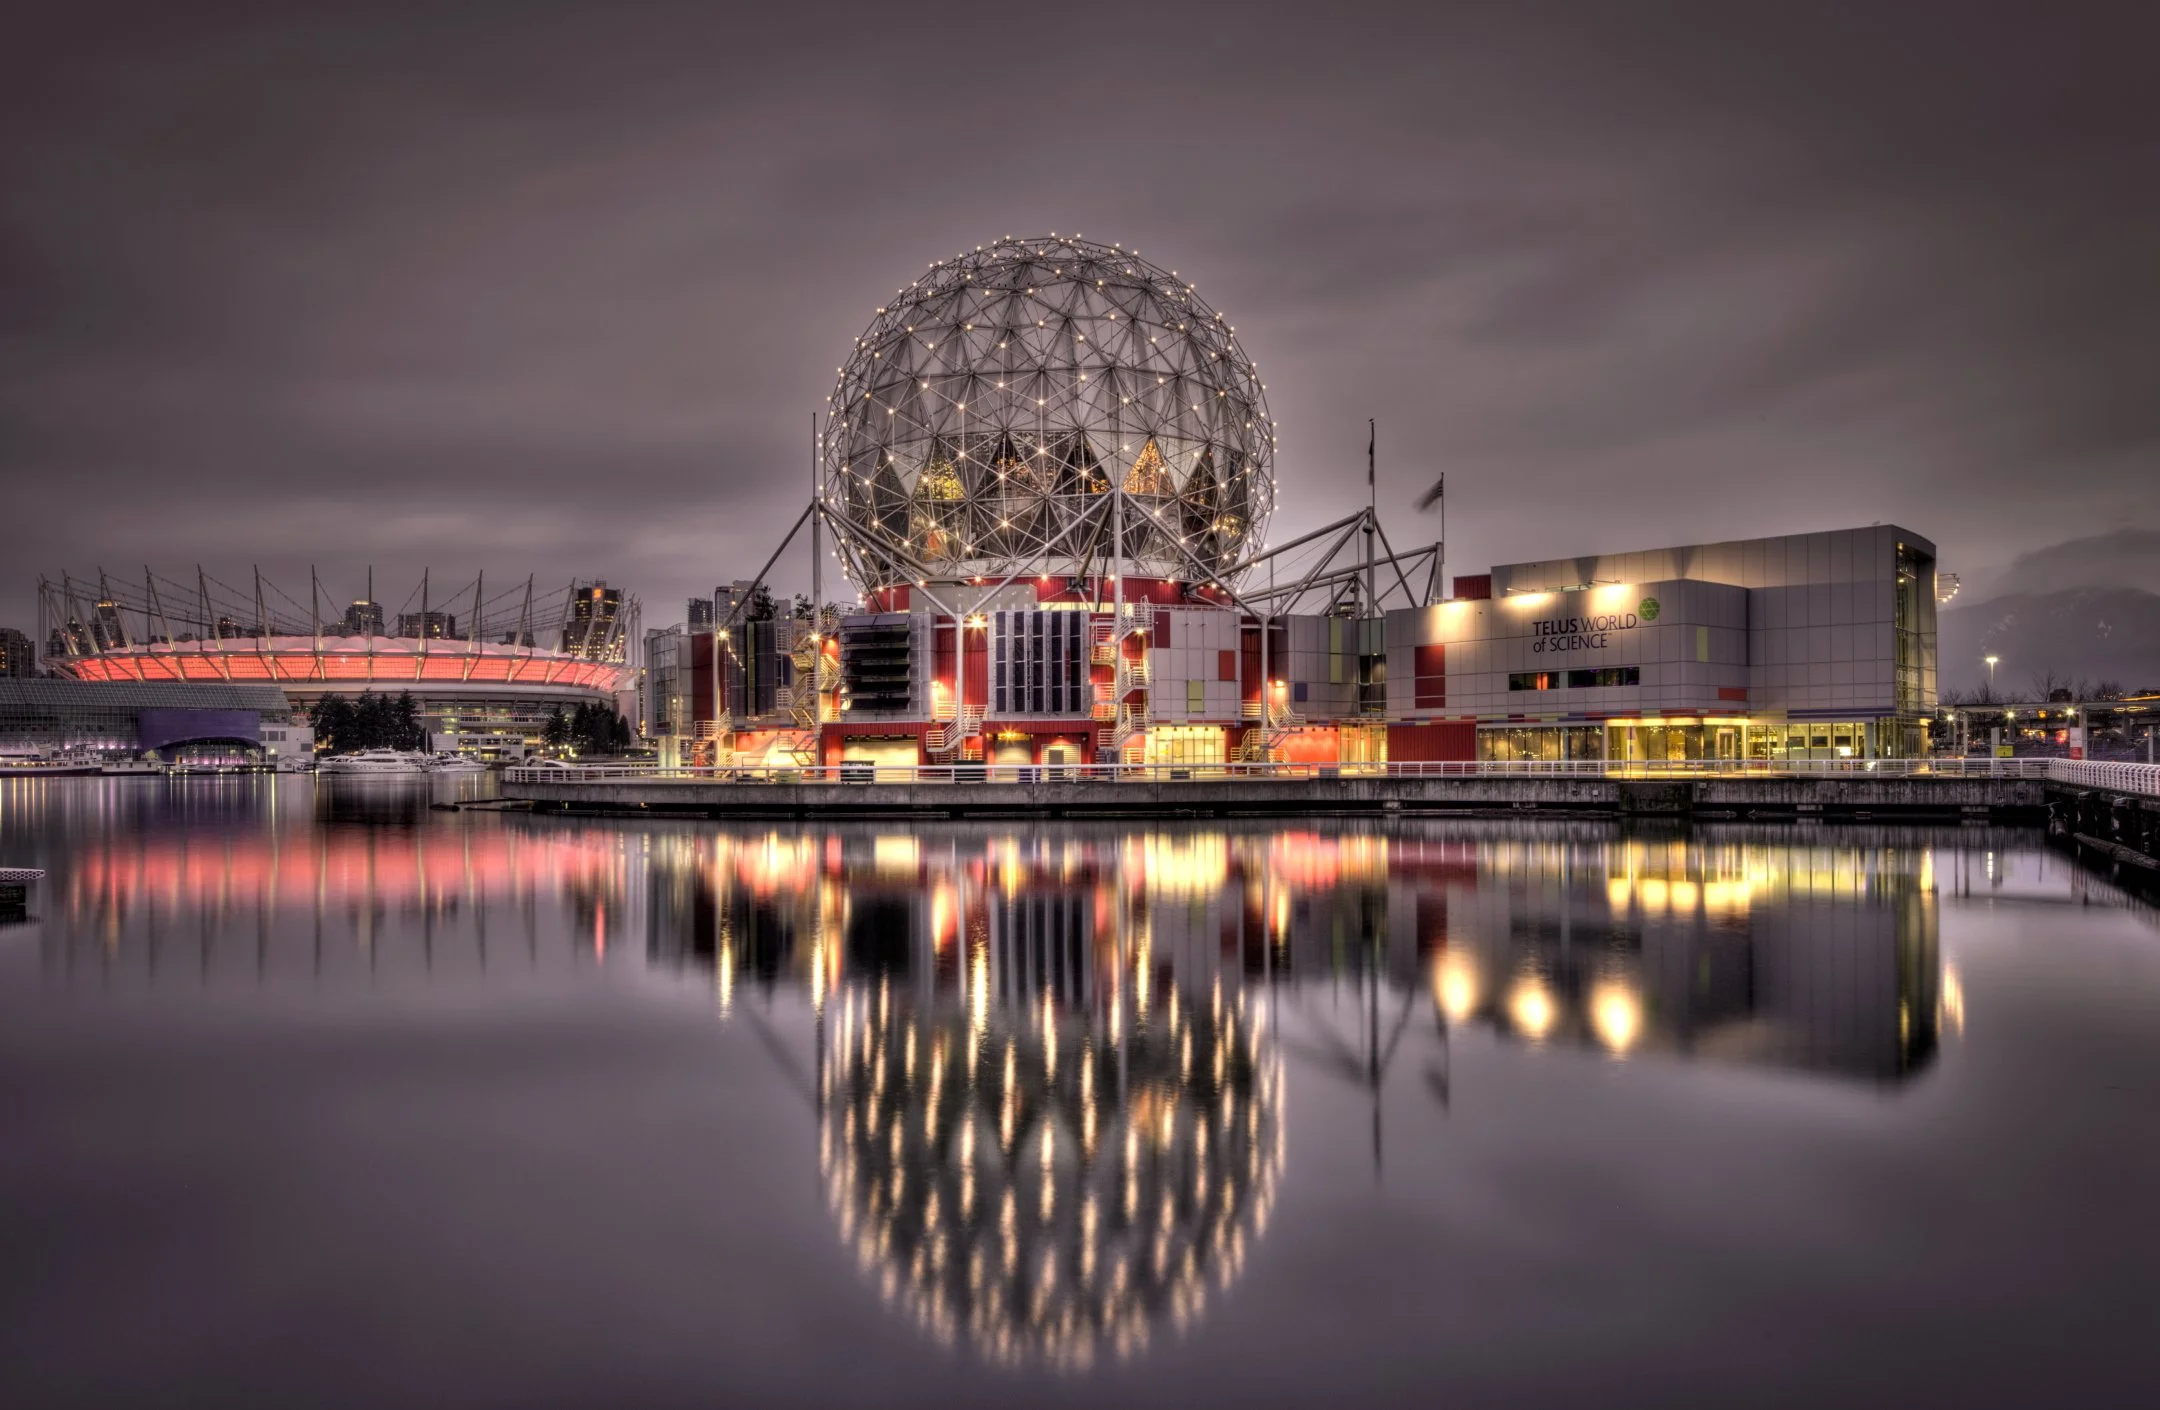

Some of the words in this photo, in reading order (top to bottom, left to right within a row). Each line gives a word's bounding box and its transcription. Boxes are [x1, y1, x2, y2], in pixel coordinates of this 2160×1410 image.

[1533, 619, 1578, 636] TELUS
[1581, 614, 1637, 632] WORLD
[1533, 637, 1546, 653] of
[1549, 633, 1607, 651] SCIENCE
